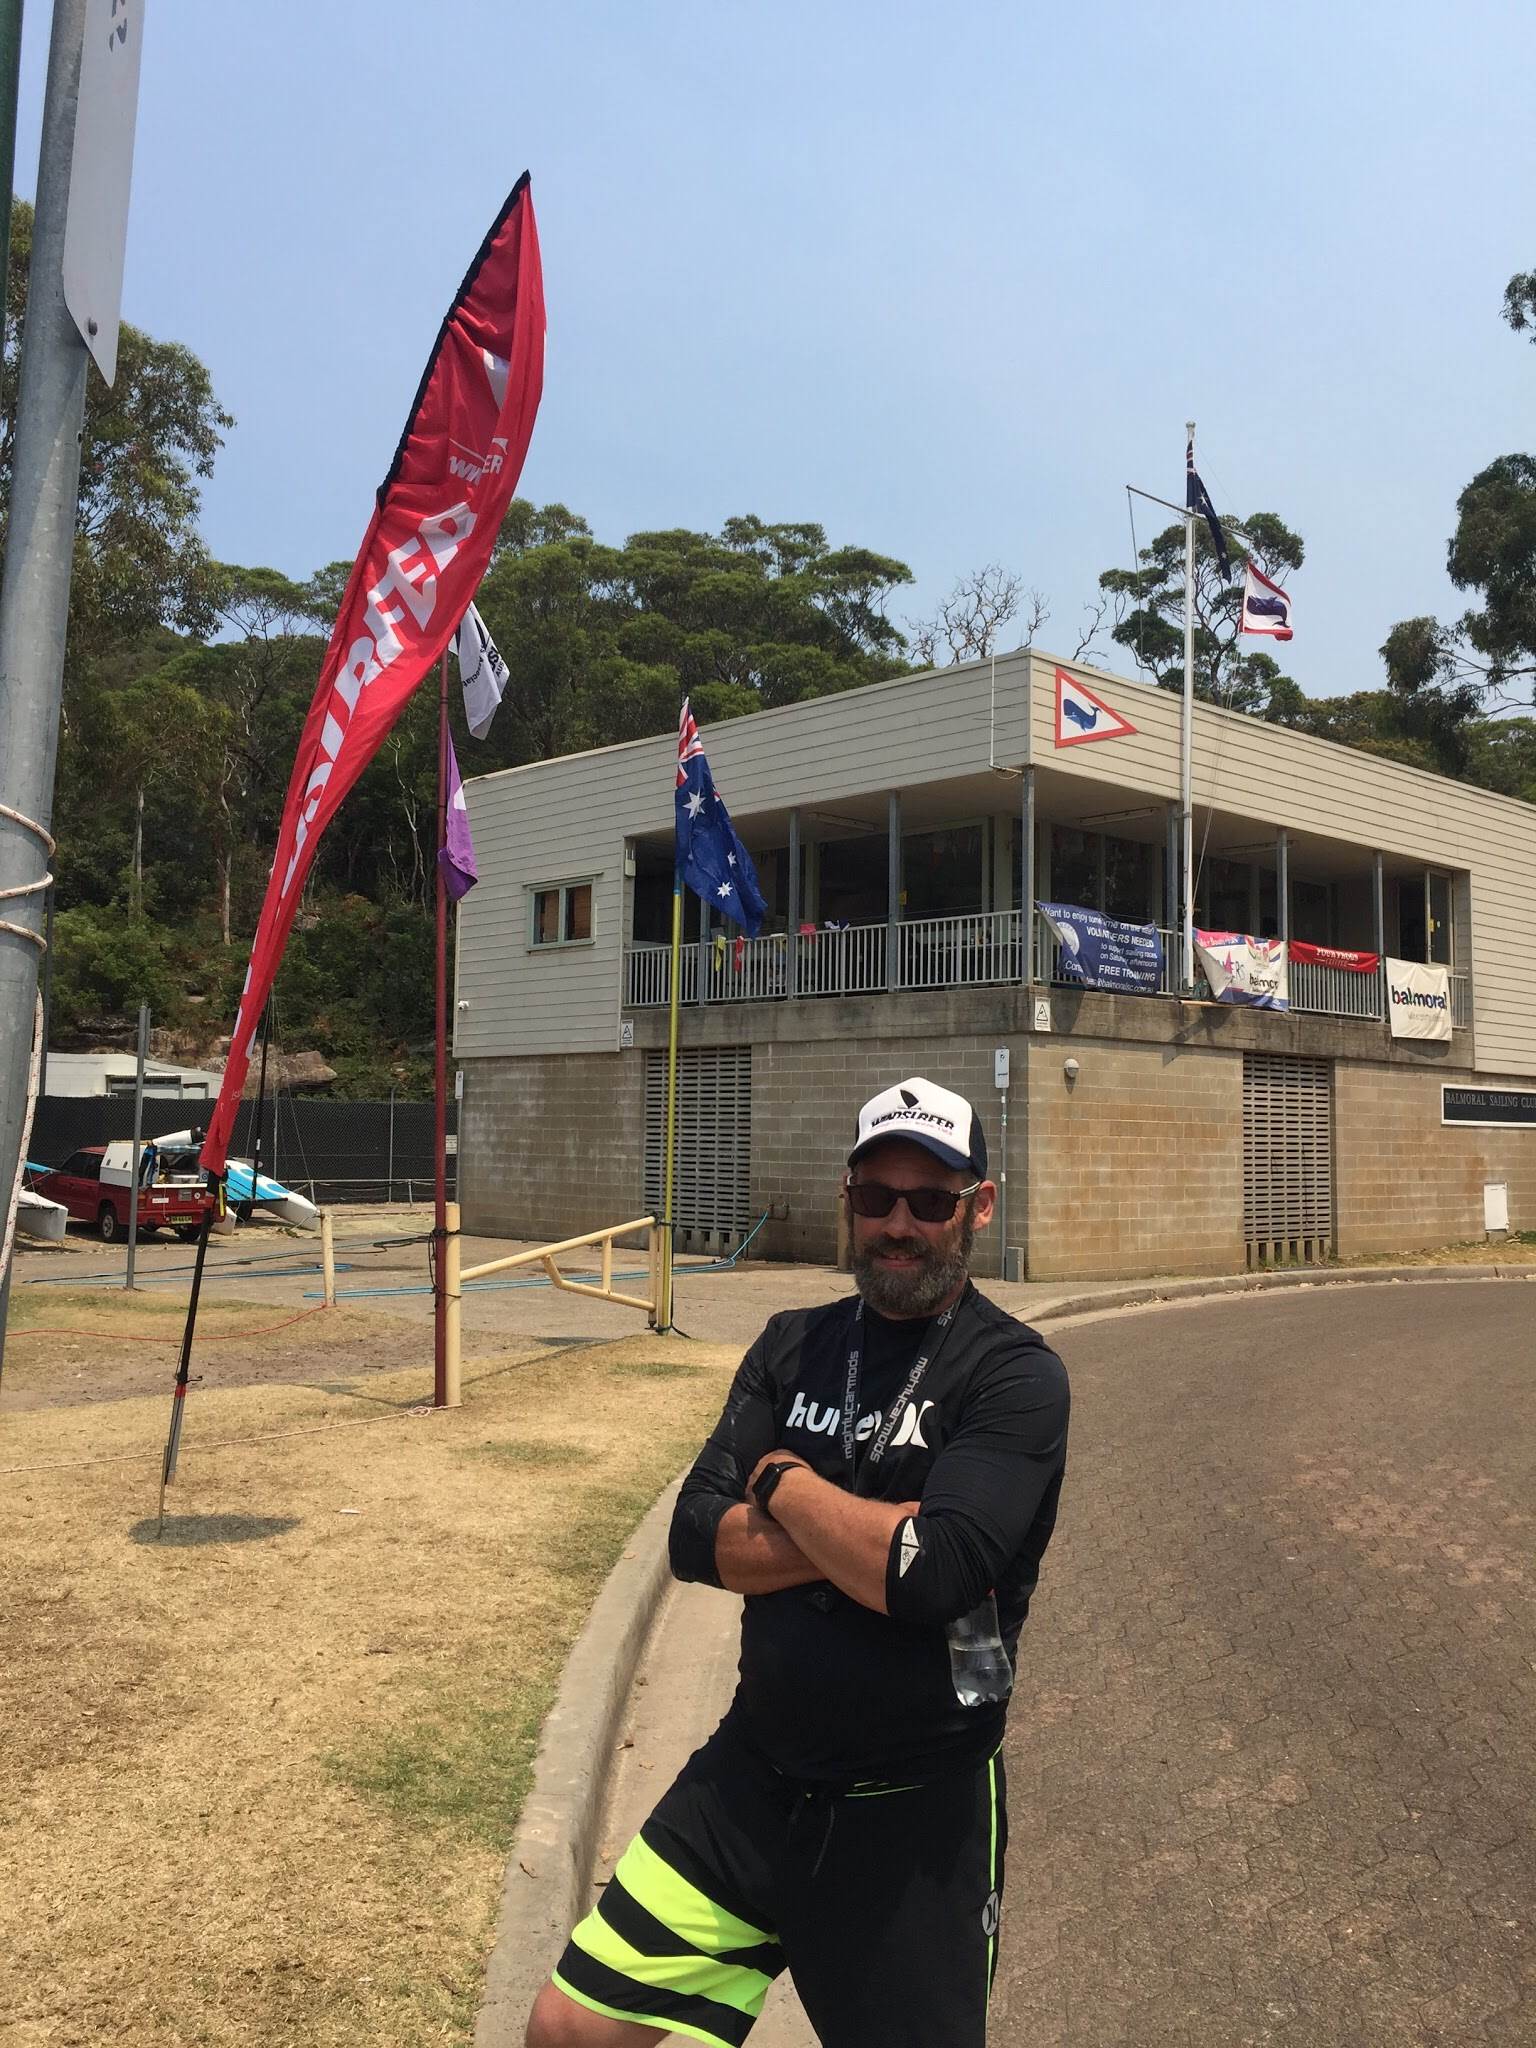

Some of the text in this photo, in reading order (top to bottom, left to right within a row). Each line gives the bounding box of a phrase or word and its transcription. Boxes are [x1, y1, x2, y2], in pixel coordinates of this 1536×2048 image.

[1098, 964, 1121, 977] FREE
[1391, 984, 1448, 1011] balmoral
[1445, 1091, 1487, 1107] BALMORAL
[1489, 1094, 1518, 1109] SAILING
[871, 1110, 955, 1131] WINDSURFER
[841, 1350, 860, 1460] mightycarmods
[869, 1356, 929, 1464] mightycarmods
